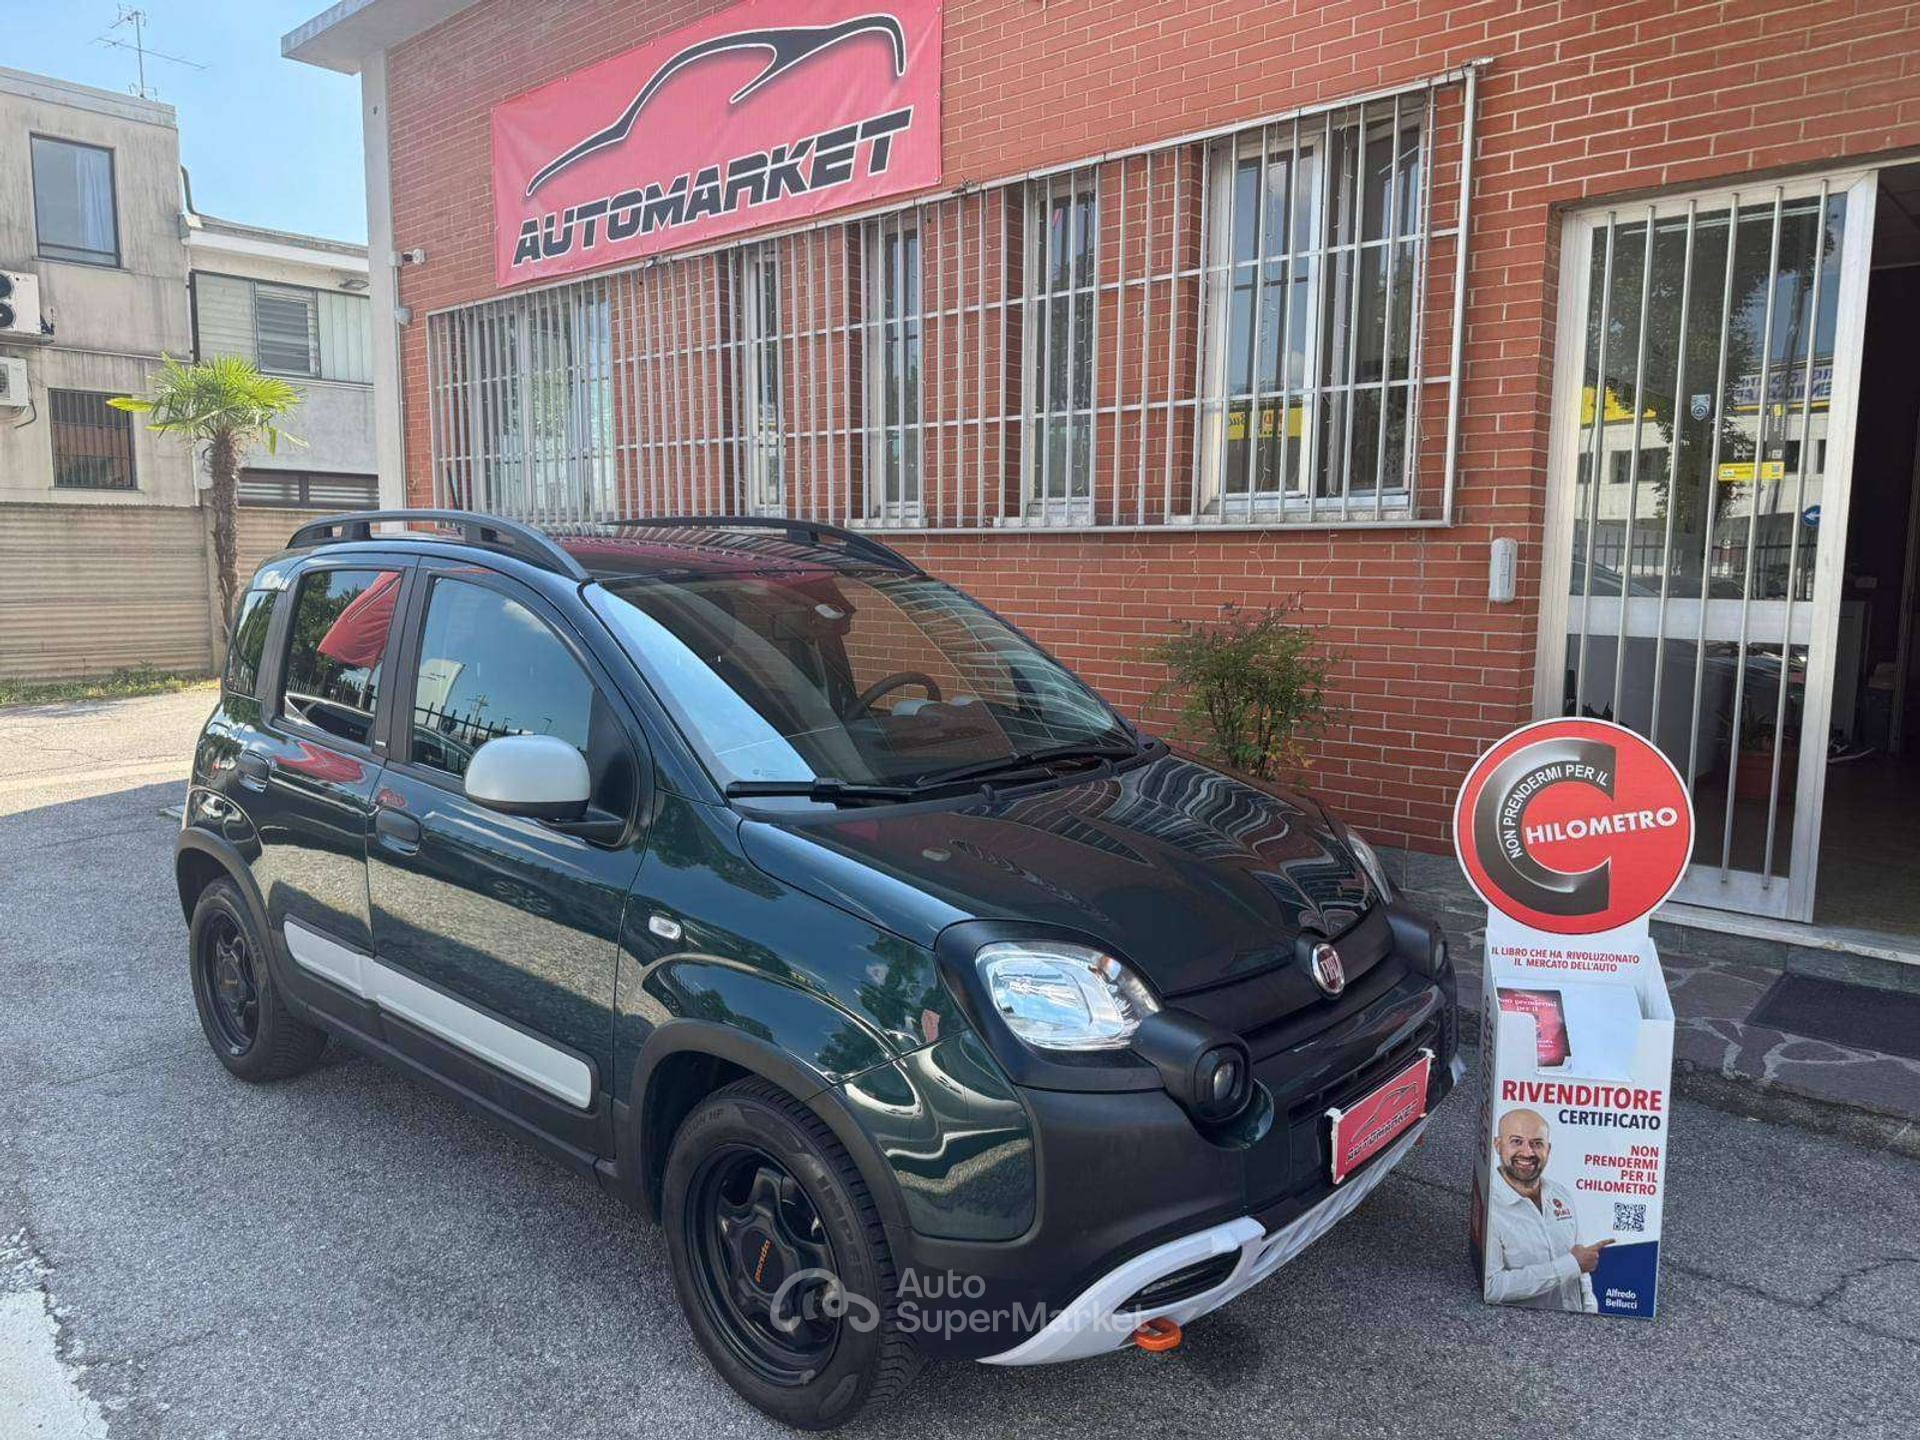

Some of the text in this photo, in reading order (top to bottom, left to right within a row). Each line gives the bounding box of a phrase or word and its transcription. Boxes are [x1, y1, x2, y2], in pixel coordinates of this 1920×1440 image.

[512, 105, 914, 268] AUTOMARKET
[1503, 764, 1609, 859] NON PRENDERMI PER IL
[1491, 946, 1640, 964] IL LIBRO CHE HA RIVOLUZIONATO
[1514, 958, 1617, 972] IL MERCATO DELL'AUTO
[1502, 1079, 1662, 1111] RIVENDITORE
[1558, 1109, 1661, 1131] CERTIFICATO
[1630, 1145, 1660, 1158] NON
[1584, 1154, 1658, 1170] PRENDERMI
[1620, 1170, 1658, 1183] PER IL
[1576, 1178, 1657, 1196] CHILOMETRO
[1605, 1288, 1637, 1299] Alfredo
[1605, 1298, 1638, 1310] Bellucci
